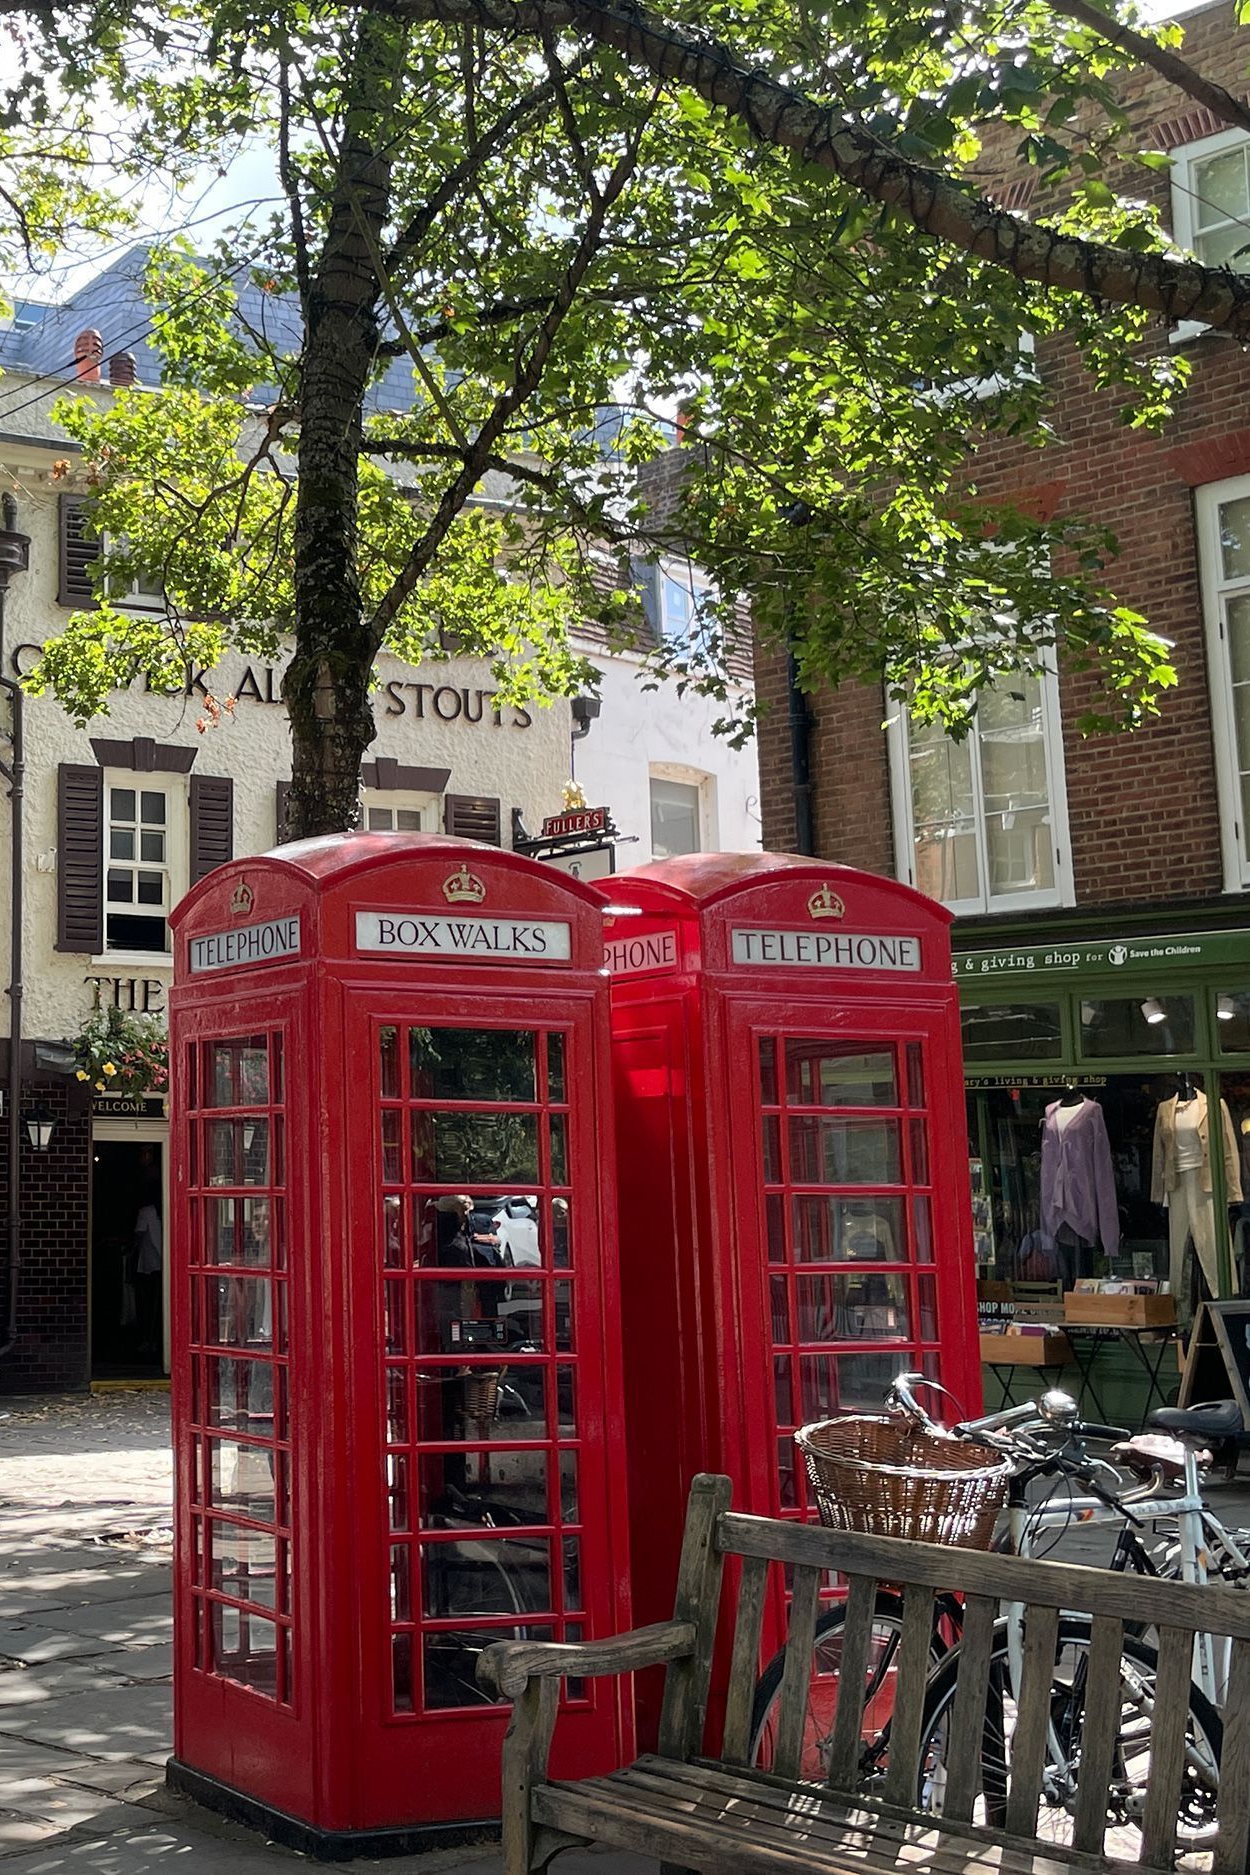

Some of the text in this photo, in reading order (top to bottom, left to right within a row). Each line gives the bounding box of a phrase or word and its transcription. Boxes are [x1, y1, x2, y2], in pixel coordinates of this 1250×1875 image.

[546, 811, 599, 836] FULLER'S
[195, 920, 299, 967] TELEPHONE
[378, 919, 547, 953] BOX WALKS
[738, 933, 914, 966] TELEPHONE
[965, 958, 974, 970] &
[981, 954, 1035, 972] giving
[1044, 951, 1081, 966] shop
[1086, 953, 1103, 962] for
[1129, 945, 1201, 958] Save the Children
[84, 976, 166, 1013] THE
[995, 1076, 1029, 1087] living
[1042, 1075, 1079, 1087] giving
[1083, 1074, 1108, 1085] shop
